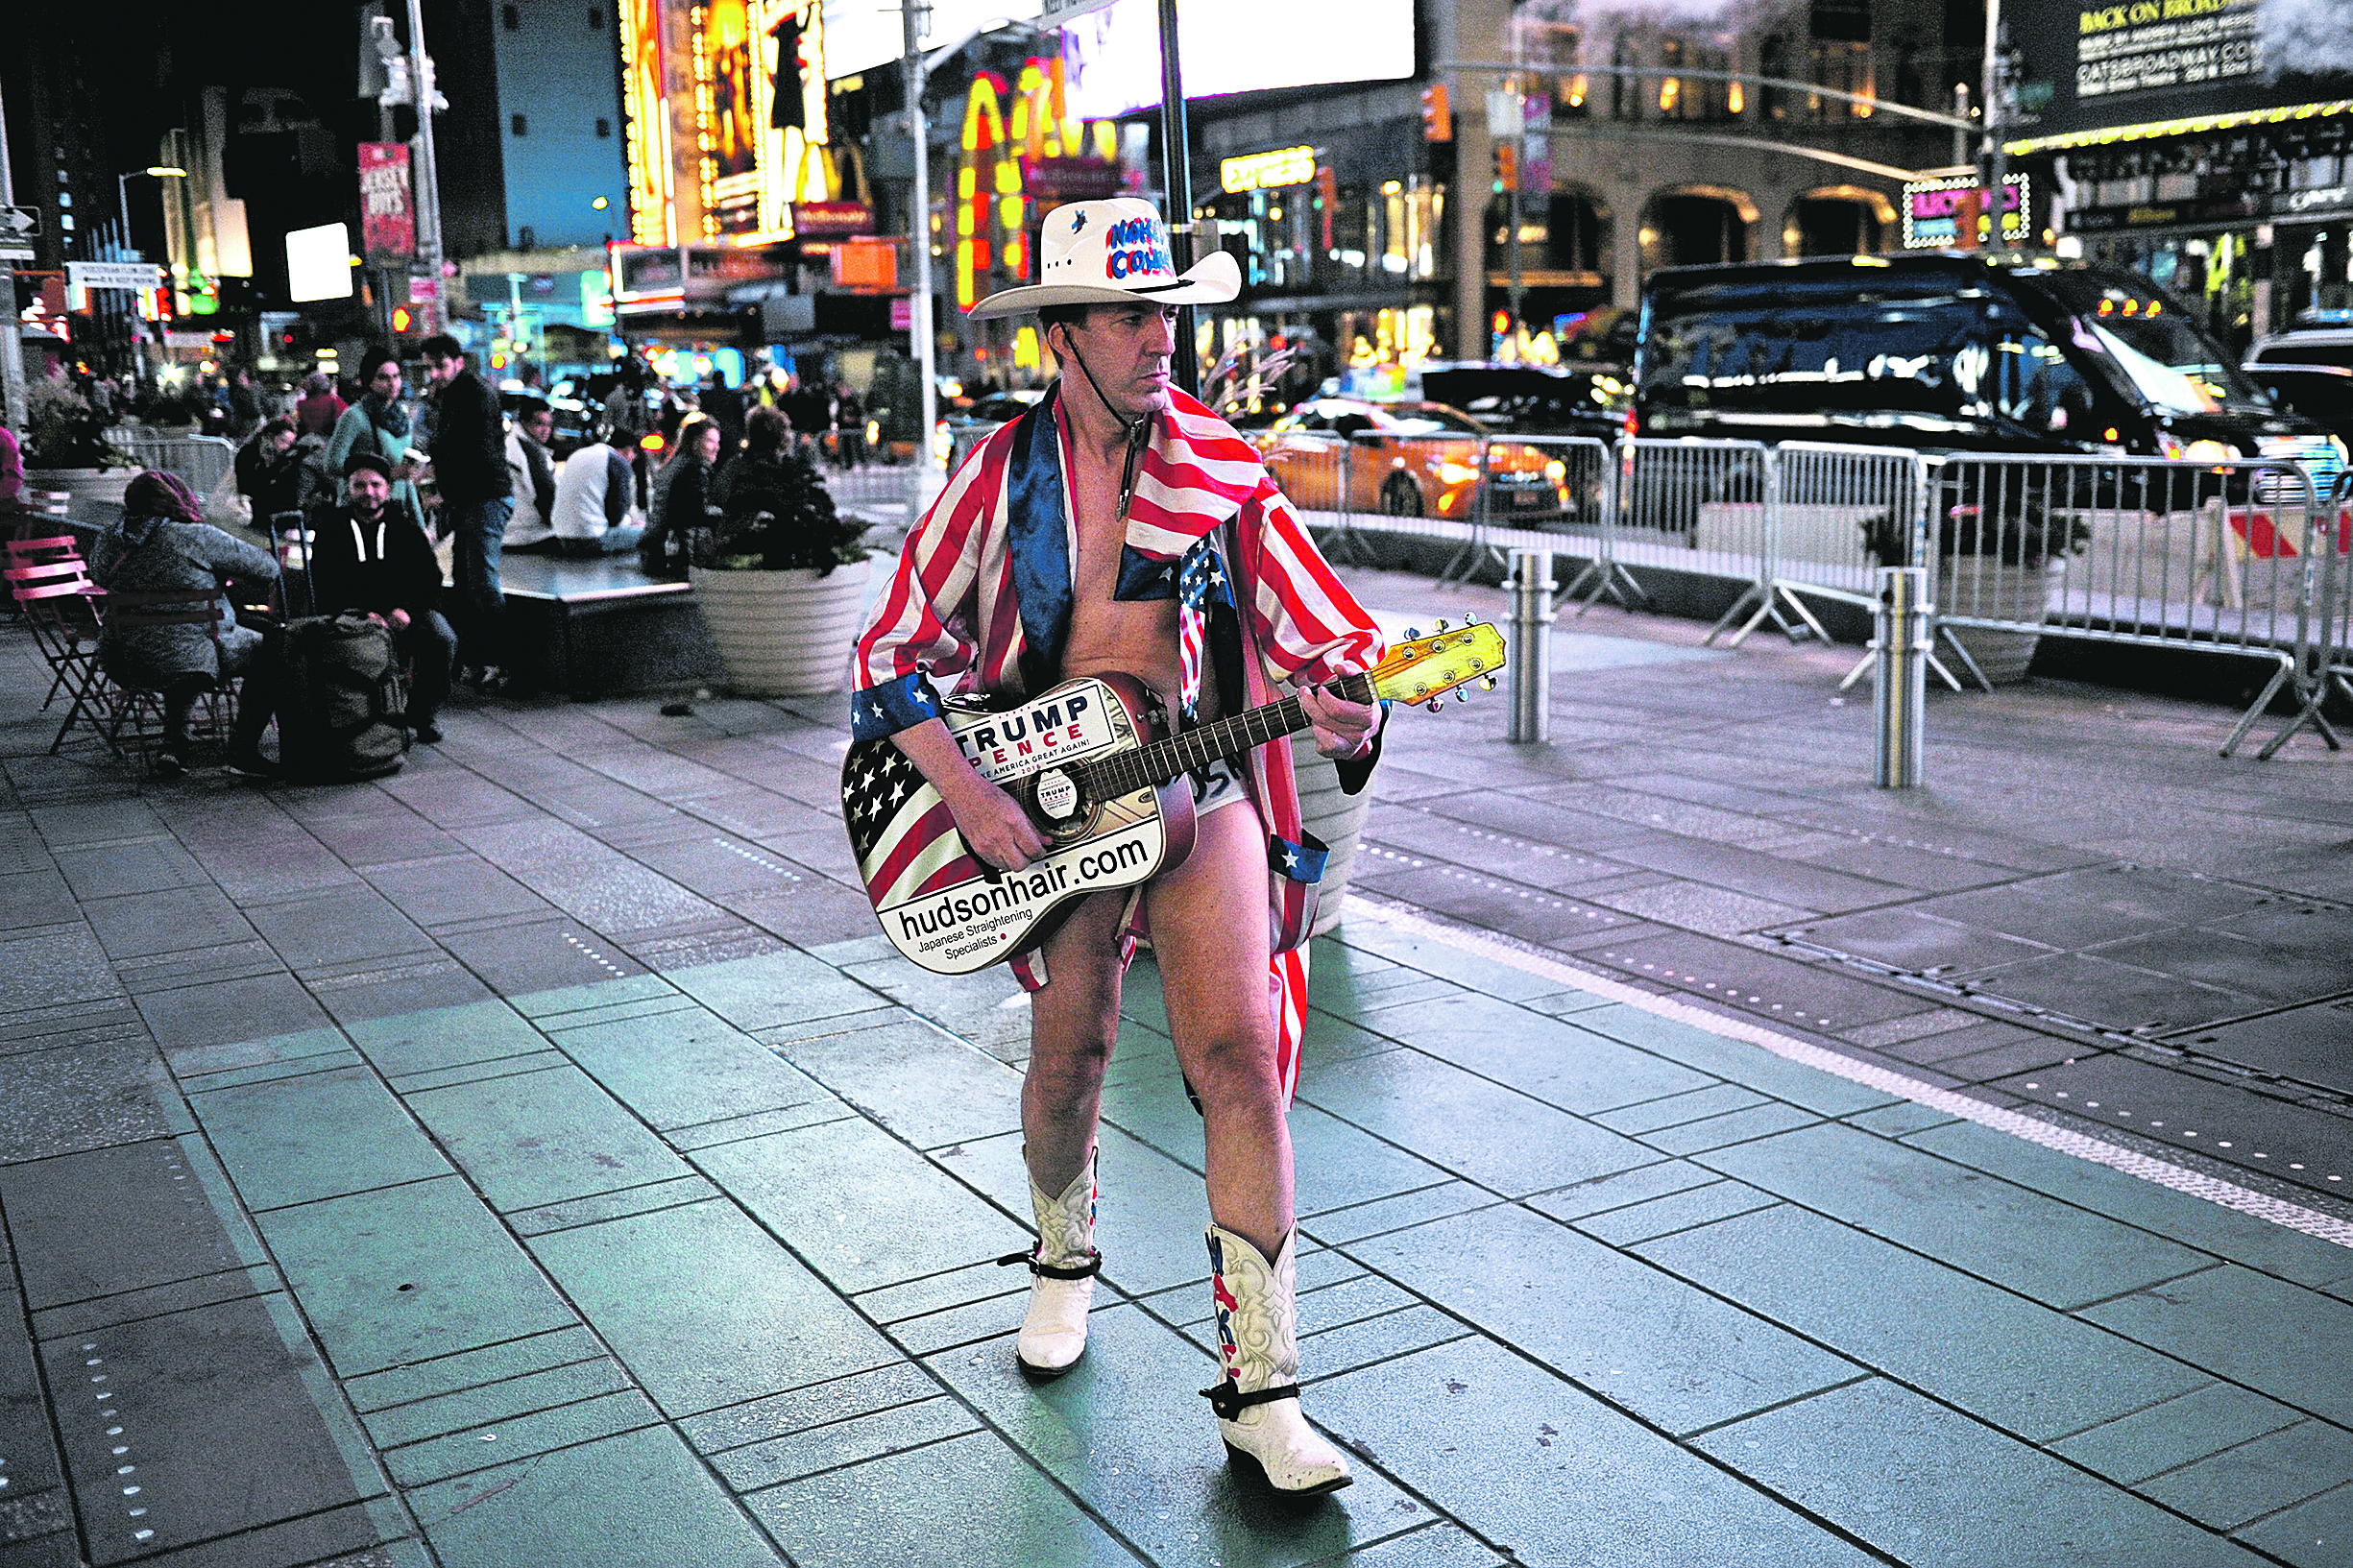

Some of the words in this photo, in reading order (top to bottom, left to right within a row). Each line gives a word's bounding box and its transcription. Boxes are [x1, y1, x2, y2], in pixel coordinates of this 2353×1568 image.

[2079, 6, 2128, 34] BACK
[2129, 0, 2160, 25] ON
[955, 696, 1088, 757] TRUMP
[968, 724, 1083, 768] PENCE
[994, 760, 1030, 775] AMERICA
[1031, 750, 1057, 763] GREAT
[1060, 738, 1090, 754] AGAIN!
[1040, 785, 1071, 798] TRUMP
[899, 839, 1148, 940] hudsonhair.com
[918, 929, 965, 953] Japanese
[966, 908, 1033, 936] Straightening
[944, 934, 998, 960] Specialists
